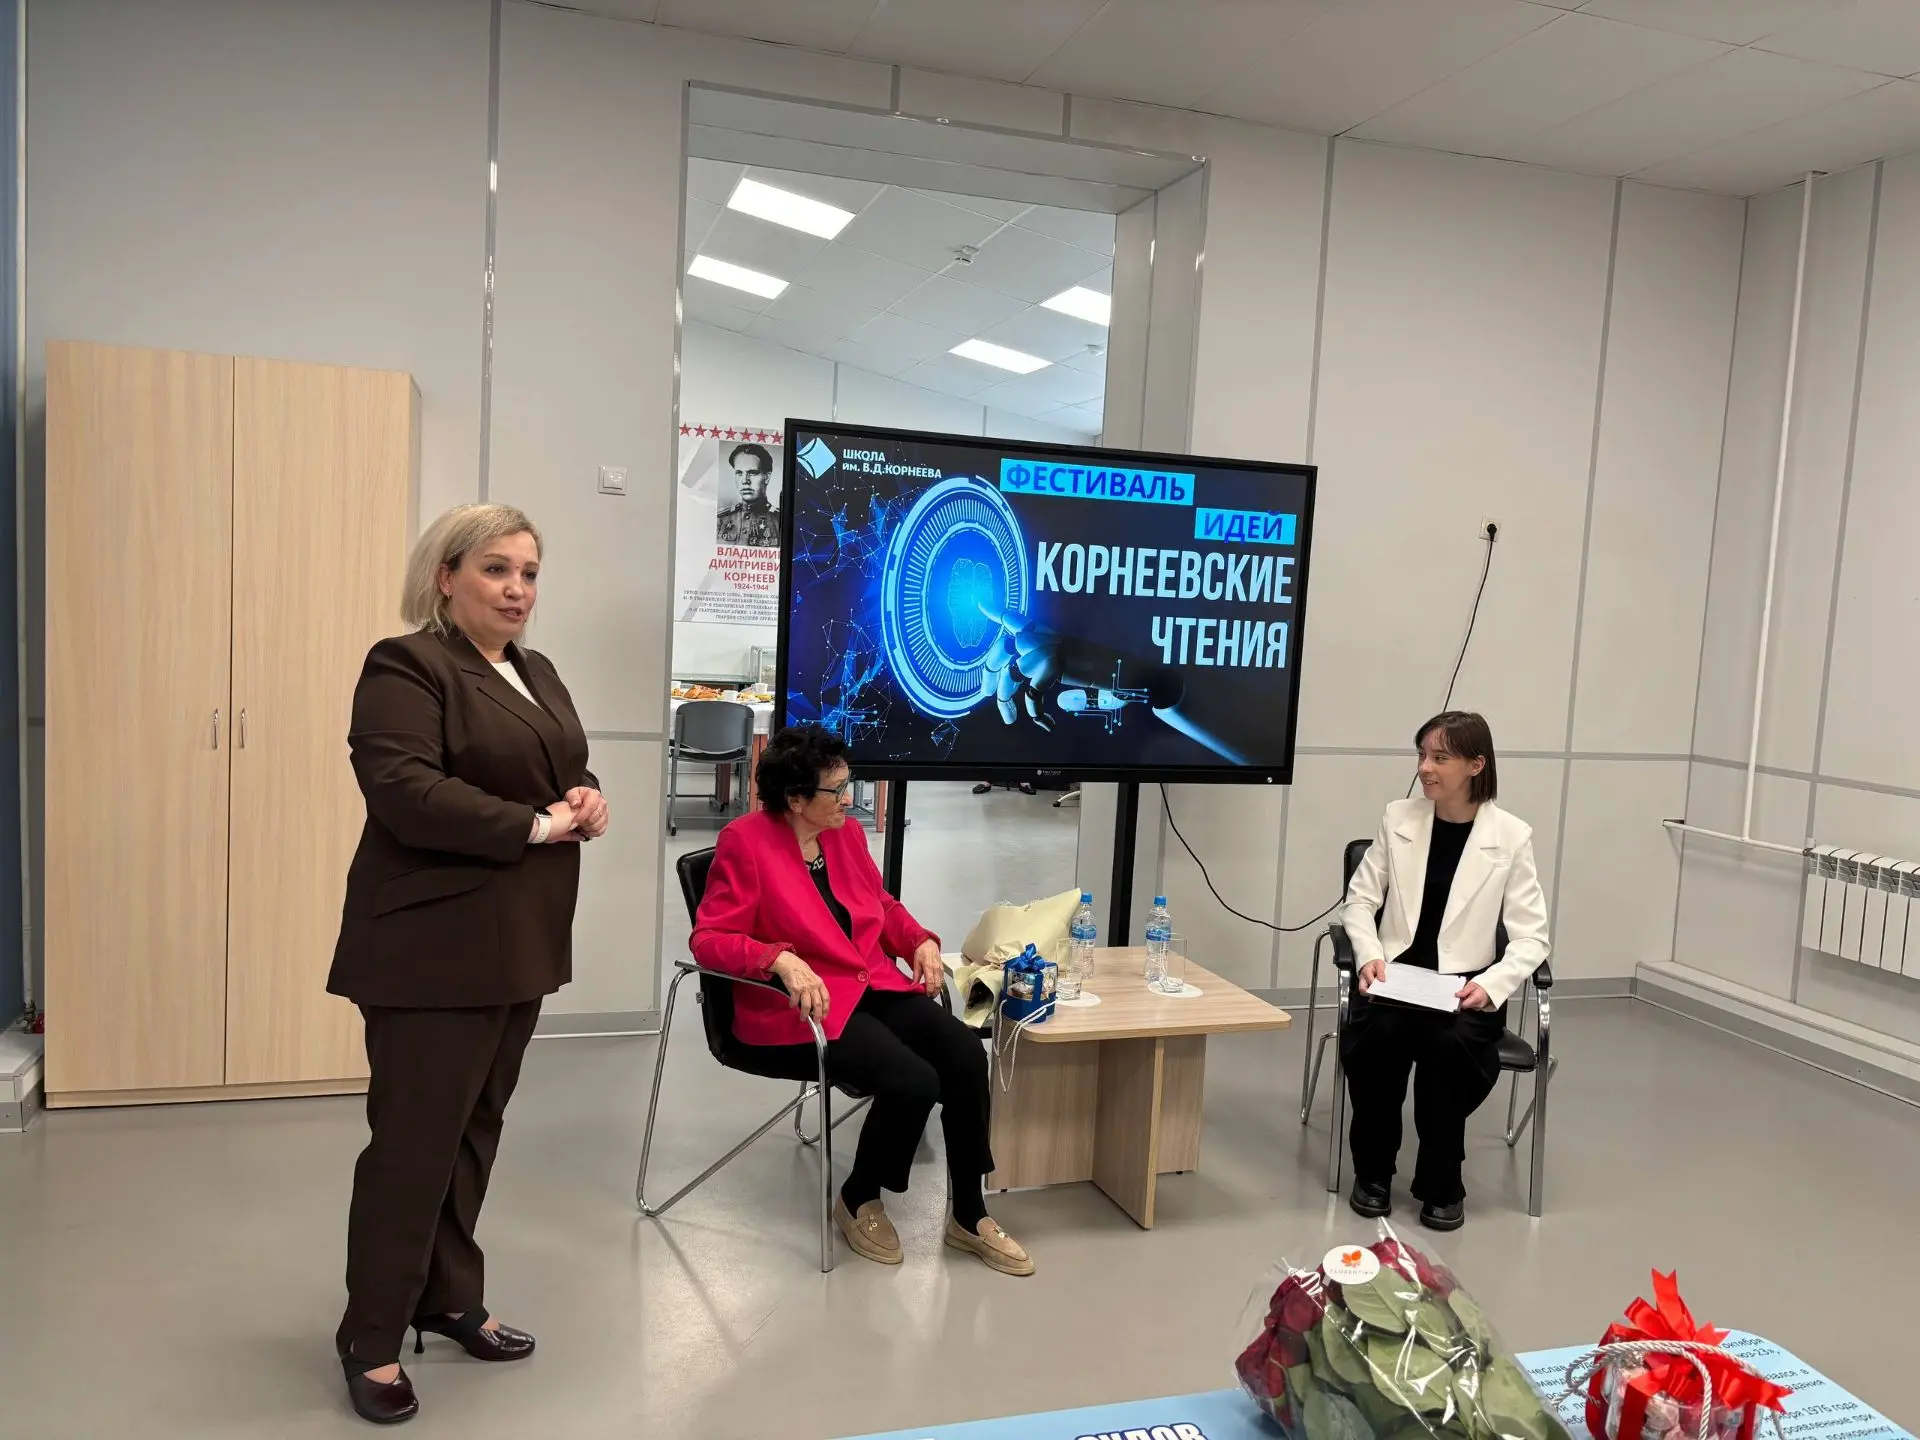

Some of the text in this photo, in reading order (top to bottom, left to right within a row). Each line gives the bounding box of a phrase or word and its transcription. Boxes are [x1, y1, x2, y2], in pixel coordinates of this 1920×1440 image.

[843, 449, 886, 462] ШКОЛА
[842, 462, 942, 478] им. В.Д.КОРНЕЕВА
[1006, 464, 1186, 501] ФЕСТИВАЛЬ
[1204, 510, 1284, 544] ИДЕЙ
[709, 559, 780, 571] ДМИТРИЕВИ
[1035, 541, 1296, 604] КОРНЕЕВСКИЕ
[724, 572, 776, 583] КОРНЕЕВ
[1151, 616, 1289, 669] ЧТЕНИЯ
[1802, 1404, 1832, 1416] 1976
[1831, 1401, 1858, 1412] года
